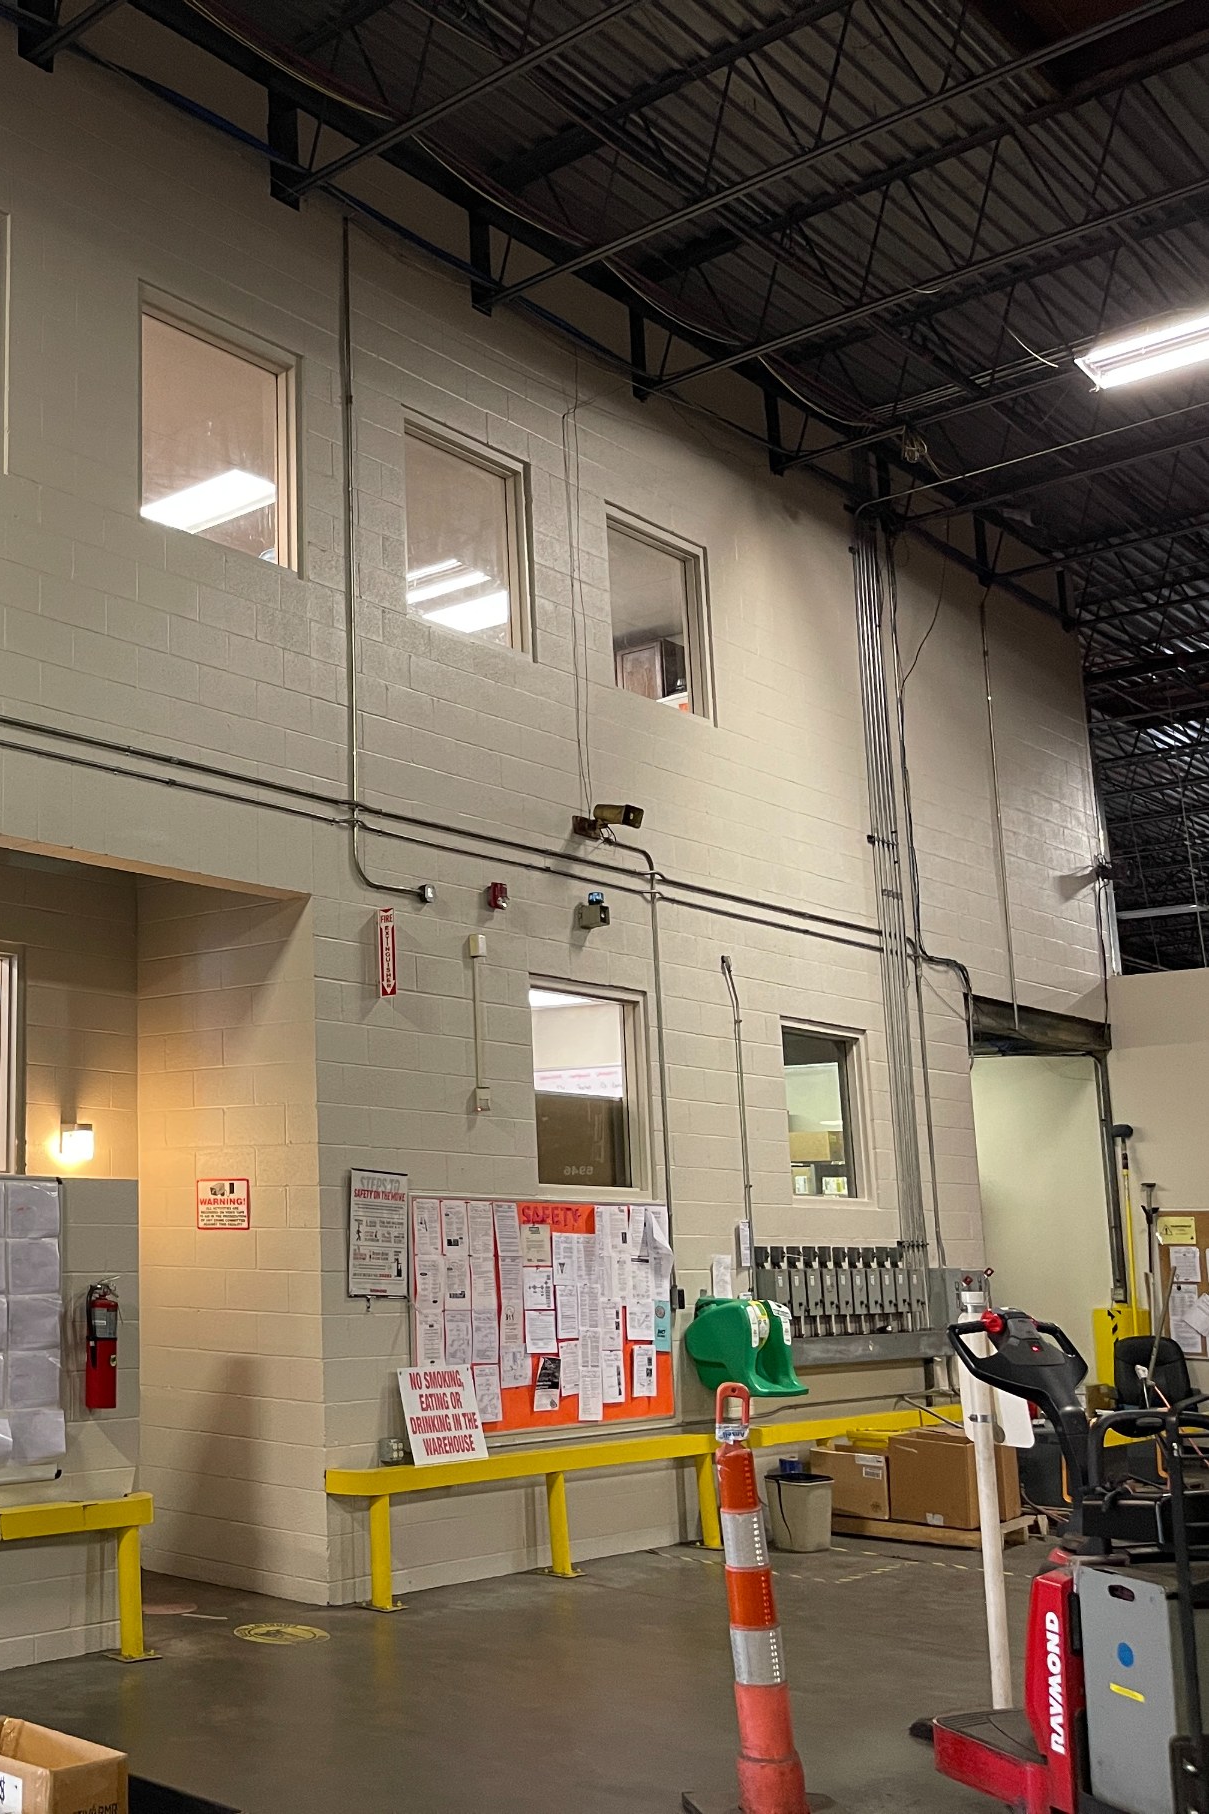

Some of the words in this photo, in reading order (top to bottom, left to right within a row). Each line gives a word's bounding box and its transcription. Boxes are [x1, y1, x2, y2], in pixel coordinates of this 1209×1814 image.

[380, 914, 393, 923] FIRE
[384, 925, 392, 989] EXTINGUISHER
[360, 1175, 387, 1190] STEPS
[199, 1198, 246, 1206] WARNING!
[353, 1188, 374, 1199] SAFETY
[373, 1190, 381, 1199] ON
[391, 1192, 406, 1202] MOVE
[521, 1205, 581, 1228] SAFETY
[409, 1372, 422, 1390] NO
[423, 1370, 465, 1391] SMOKING,
[418, 1392, 449, 1412] EATING
[450, 1391, 463, 1409] OR
[409, 1414, 452, 1434] DRINKING
[451, 1412, 462, 1431] IN
[461, 1412, 479, 1430] THE
[422, 1434, 476, 1456] WAREHOUSE
[1045, 1611, 1067, 1755] RAYMOND
